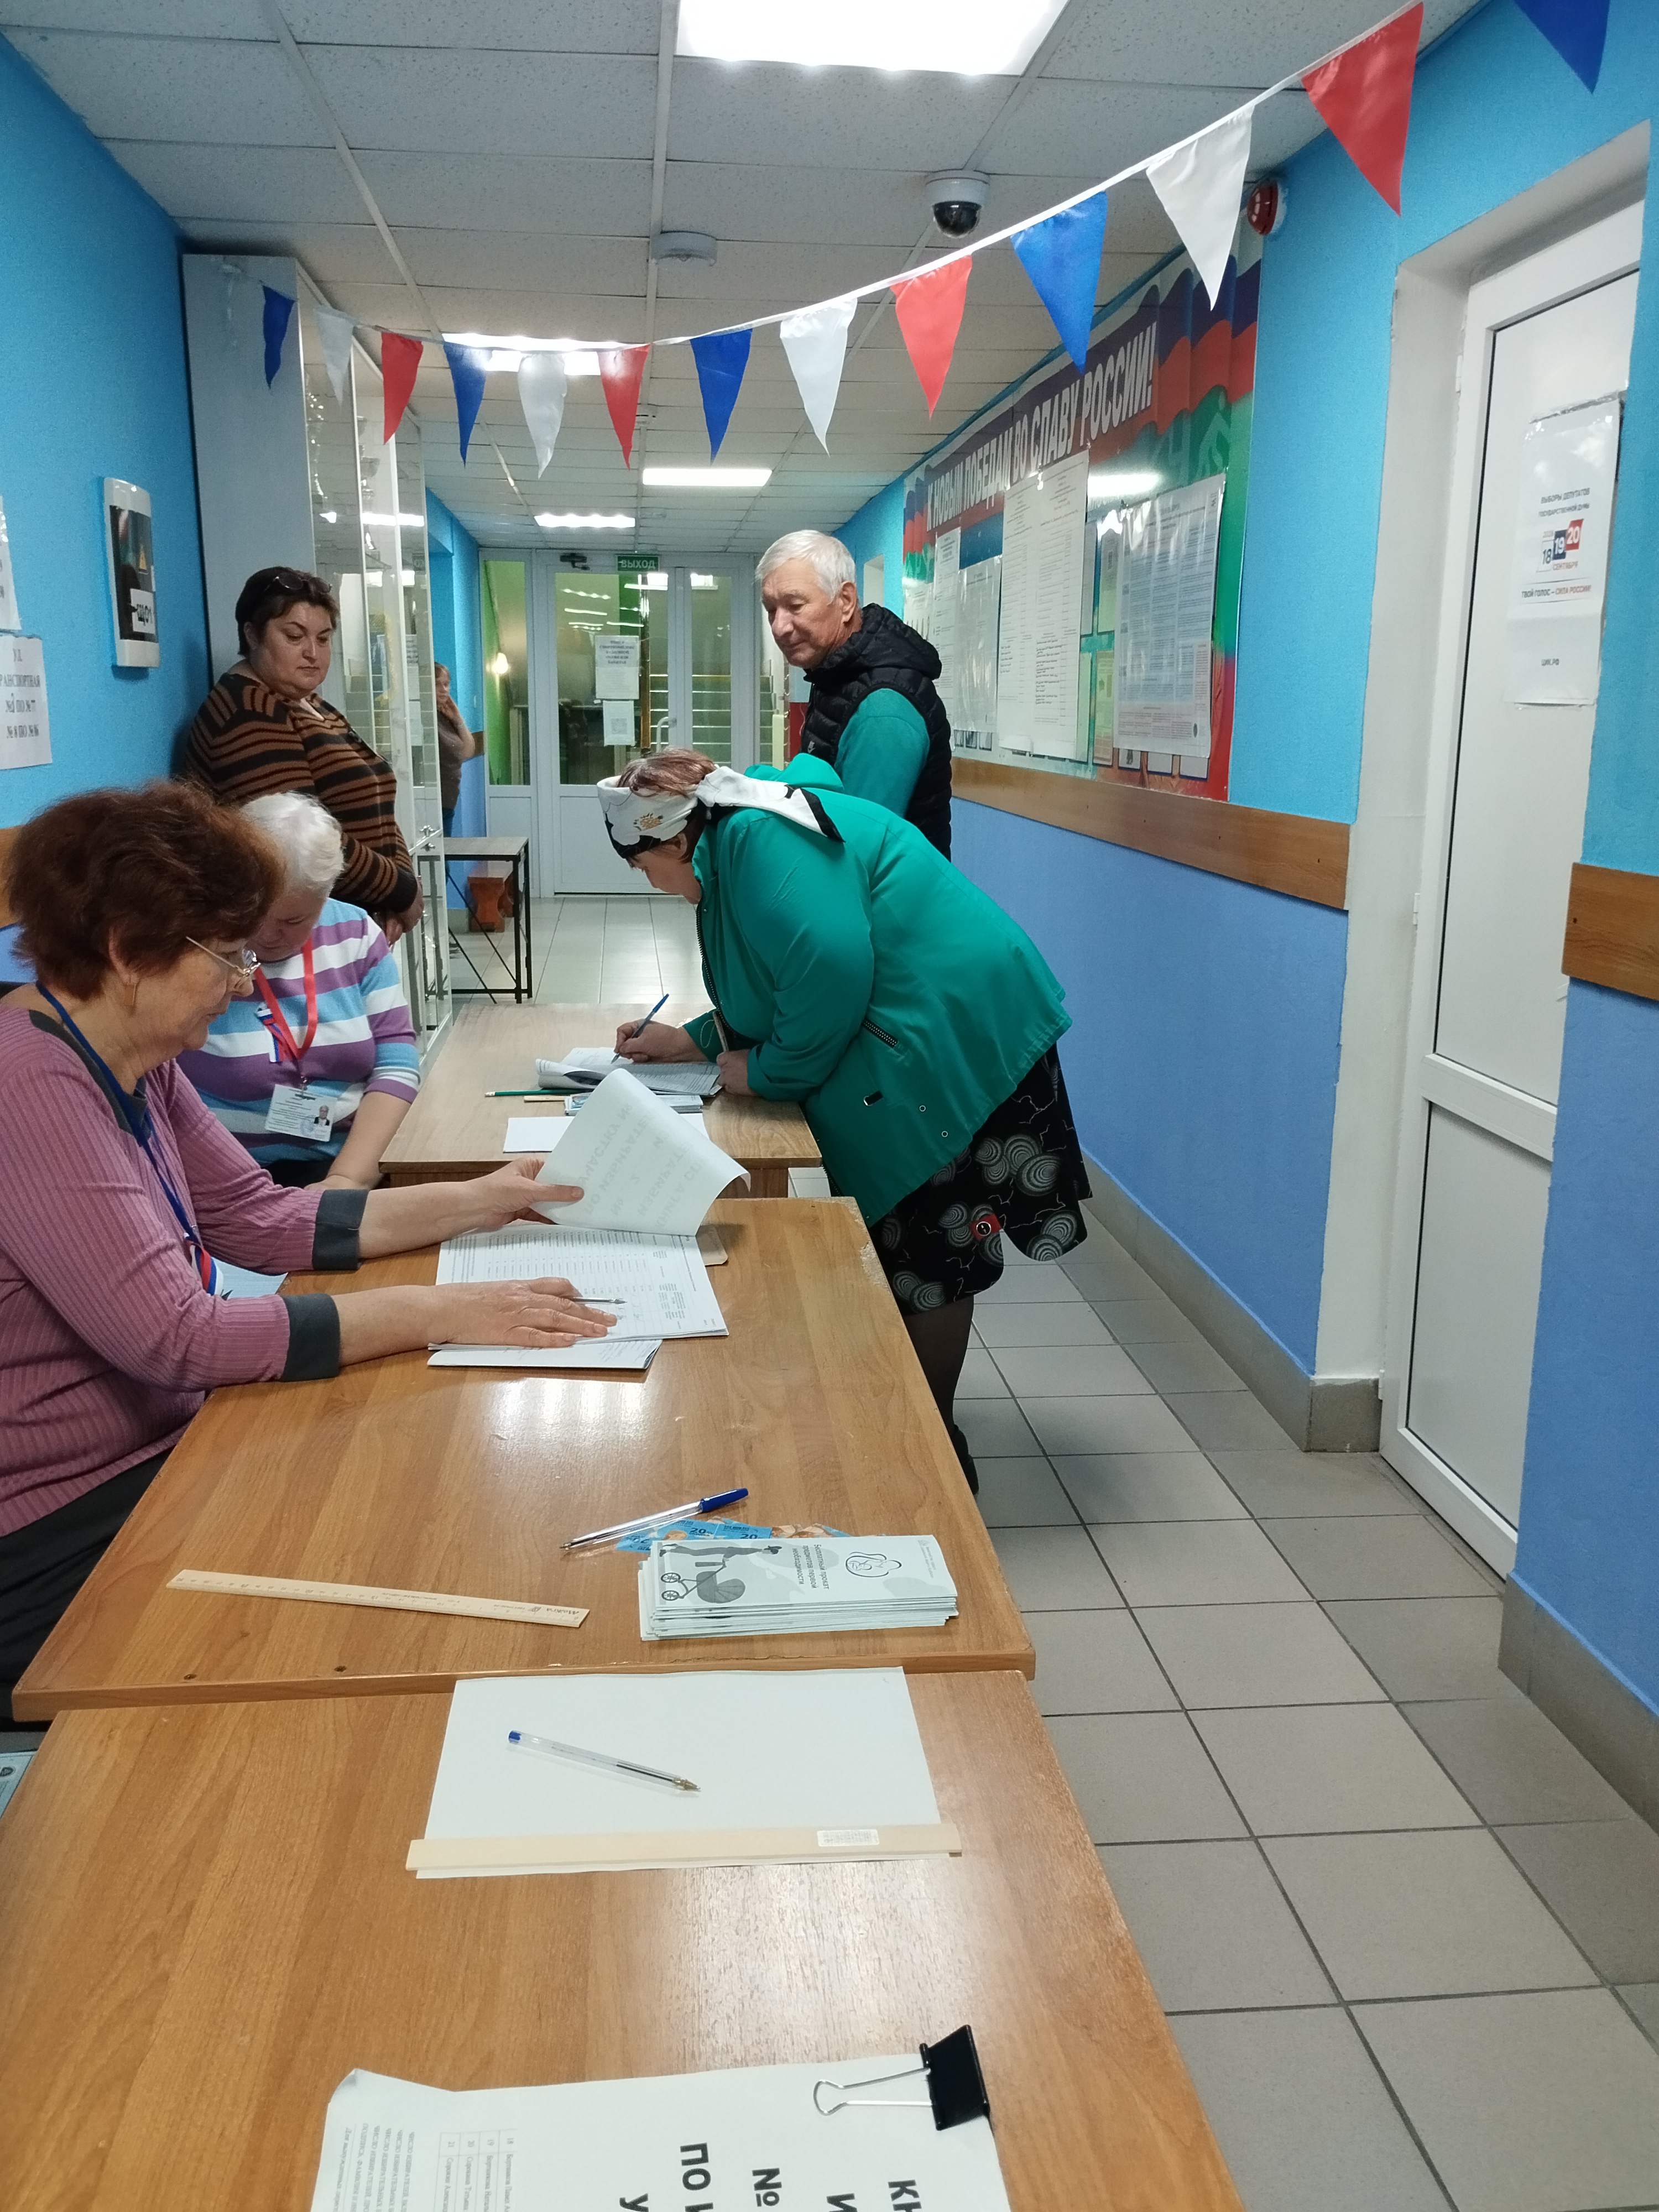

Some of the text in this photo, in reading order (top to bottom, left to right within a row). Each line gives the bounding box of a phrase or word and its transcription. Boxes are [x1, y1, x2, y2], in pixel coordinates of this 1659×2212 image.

[927, 483, 934, 531] К
[933, 462, 963, 529] НОВЫМ
[963, 427, 1013, 510] ПОБЕДАМ
[1013, 414, 1028, 483] ВО
[1030, 379, 1081, 470] СЛАВУ
[1079, 321, 1157, 447] РОССИИ!
[1541, 494, 1562, 504] ВЫБОРЫ
[1555, 536, 1564, 555] 19
[1566, 526, 1580, 544] 20
[621, 560, 656, 570] ВЫХОД
[1542, 549, 1552, 565] 18
[792, 1548, 804, 1585] необходимости
[802, 1545, 819, 1589] предметов первой
[814, 1545, 829, 1589] Бесплатный прокат
[680, 2143, 711, 2190] ПО
[752, 2168, 782, 2207] №
